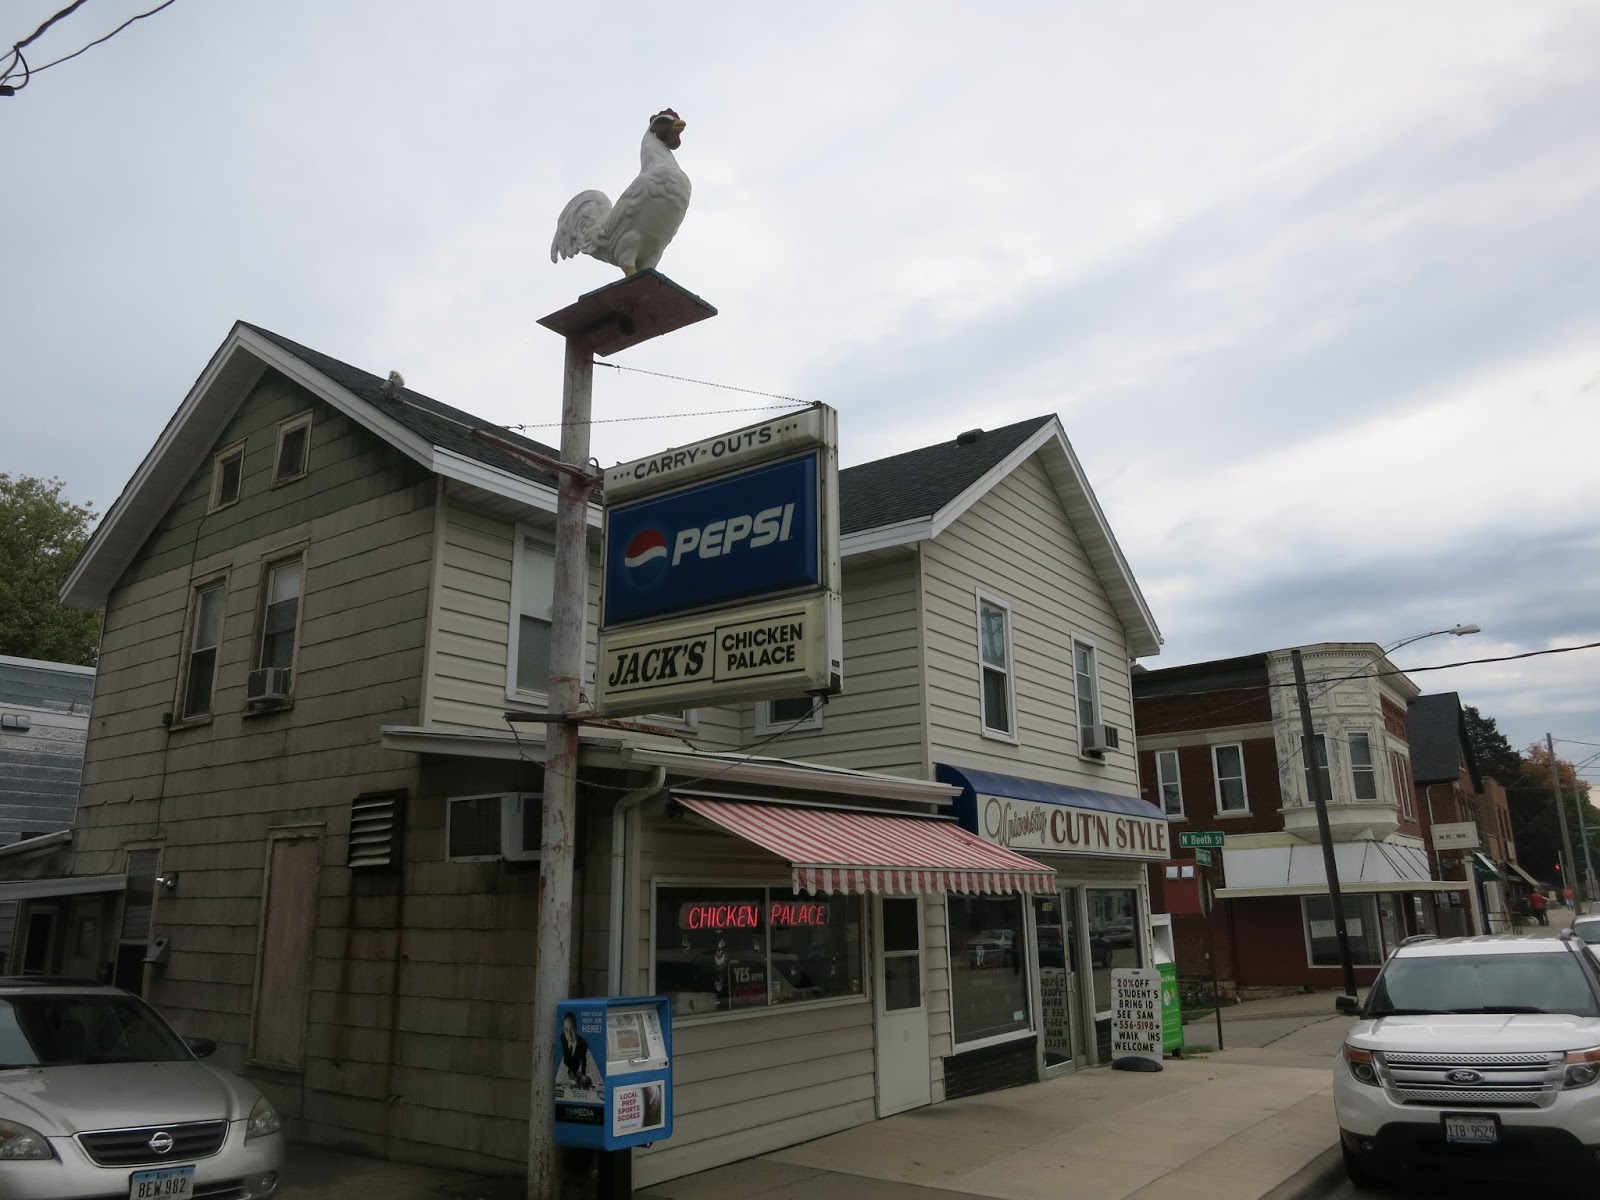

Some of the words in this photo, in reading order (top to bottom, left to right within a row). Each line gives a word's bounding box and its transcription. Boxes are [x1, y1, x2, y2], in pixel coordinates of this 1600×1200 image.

[672, 503, 795, 567] PEPSI
[721, 622, 803, 651] CHICKEN
[727, 644, 795, 671] PALACE
[608, 640, 707, 687] JACK'S
[1051, 809, 1110, 847] CUT'N
[1115, 817, 1167, 851] STYLE
[1182, 835, 1187, 845] N
[1191, 834, 1212, 845] Booth
[1214, 835, 1222, 845] St
[689, 905, 758, 929] CHICKEN
[770, 904, 825, 925] PALACE
[734, 967, 750, 982] YES
[1119, 1000, 1143, 1009] BRING
[1145, 1000, 1153, 1009] ID
[1117, 1010, 1131, 1019] SEE
[1136, 1011, 1154, 1020] SAM
[581, 1025, 602, 1033] HERE!
[1119, 1021, 1154, 1030] 556-5198
[1147, 1032, 1160, 1042] INS
[1114, 1042, 1154, 1052] WELCOME
[1453, 1071, 1474, 1081] Ford
[619, 1091, 638, 1100] LOCAL
[622, 1098, 637, 1107] PREP
[617, 1105, 640, 1115] SPORTS
[617, 1112, 640, 1122] SCORES
[1448, 1124, 1466, 1137] 178
[1471, 1125, 1495, 1138] 9529
[138, 1180, 162, 1198] BEW
[165, 1178, 186, 1194] 982
